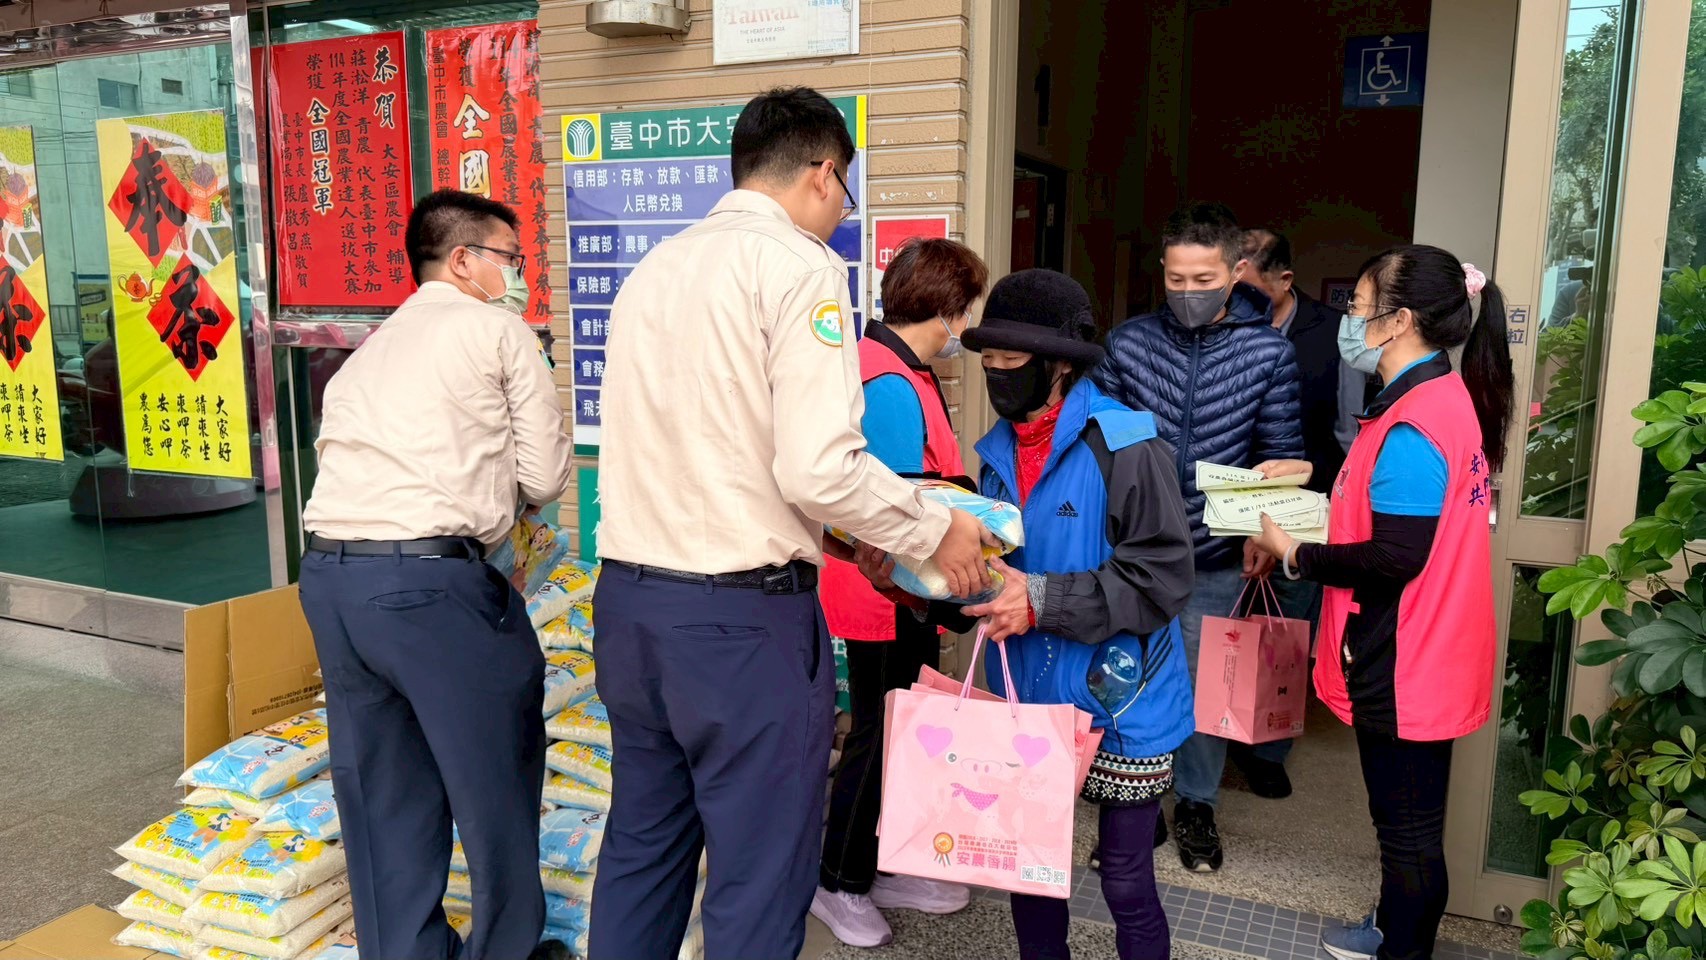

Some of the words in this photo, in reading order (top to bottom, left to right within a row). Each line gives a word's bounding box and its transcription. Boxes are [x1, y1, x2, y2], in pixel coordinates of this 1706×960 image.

[306, 53, 326, 90] 榮獲
[350, 49, 371, 105] 莊淞洋
[372, 45, 399, 129] 恭賀
[432, 46, 448, 139] 臺中市農會
[293, 112, 307, 177] 臺中市長
[307, 98, 334, 215] 全國冠軍
[354, 116, 374, 154] 青農
[453, 93, 491, 199] 全國
[329, 52, 363, 296] 114年度全國農業達人選拔大賽
[382, 143, 404, 237] 大安區農會
[623, 194, 683, 213] 人民幣兌換
[357, 165, 382, 293] 代表臺中市參加
[387, 248, 406, 285] 輔導
[577, 276, 630, 294] 保險部：
[1507, 307, 1526, 344] 右拉
[14, 383, 30, 444] 請來坐
[32, 384, 47, 446] 大家好
[157, 393, 173, 457] 安心呷
[177, 393, 192, 459] 來呷茶
[195, 394, 211, 461] 請來坐
[215, 395, 232, 462] 大家好
[1056, 510, 1078, 518] adidas
[957, 852, 1016, 871] 安農香腸
